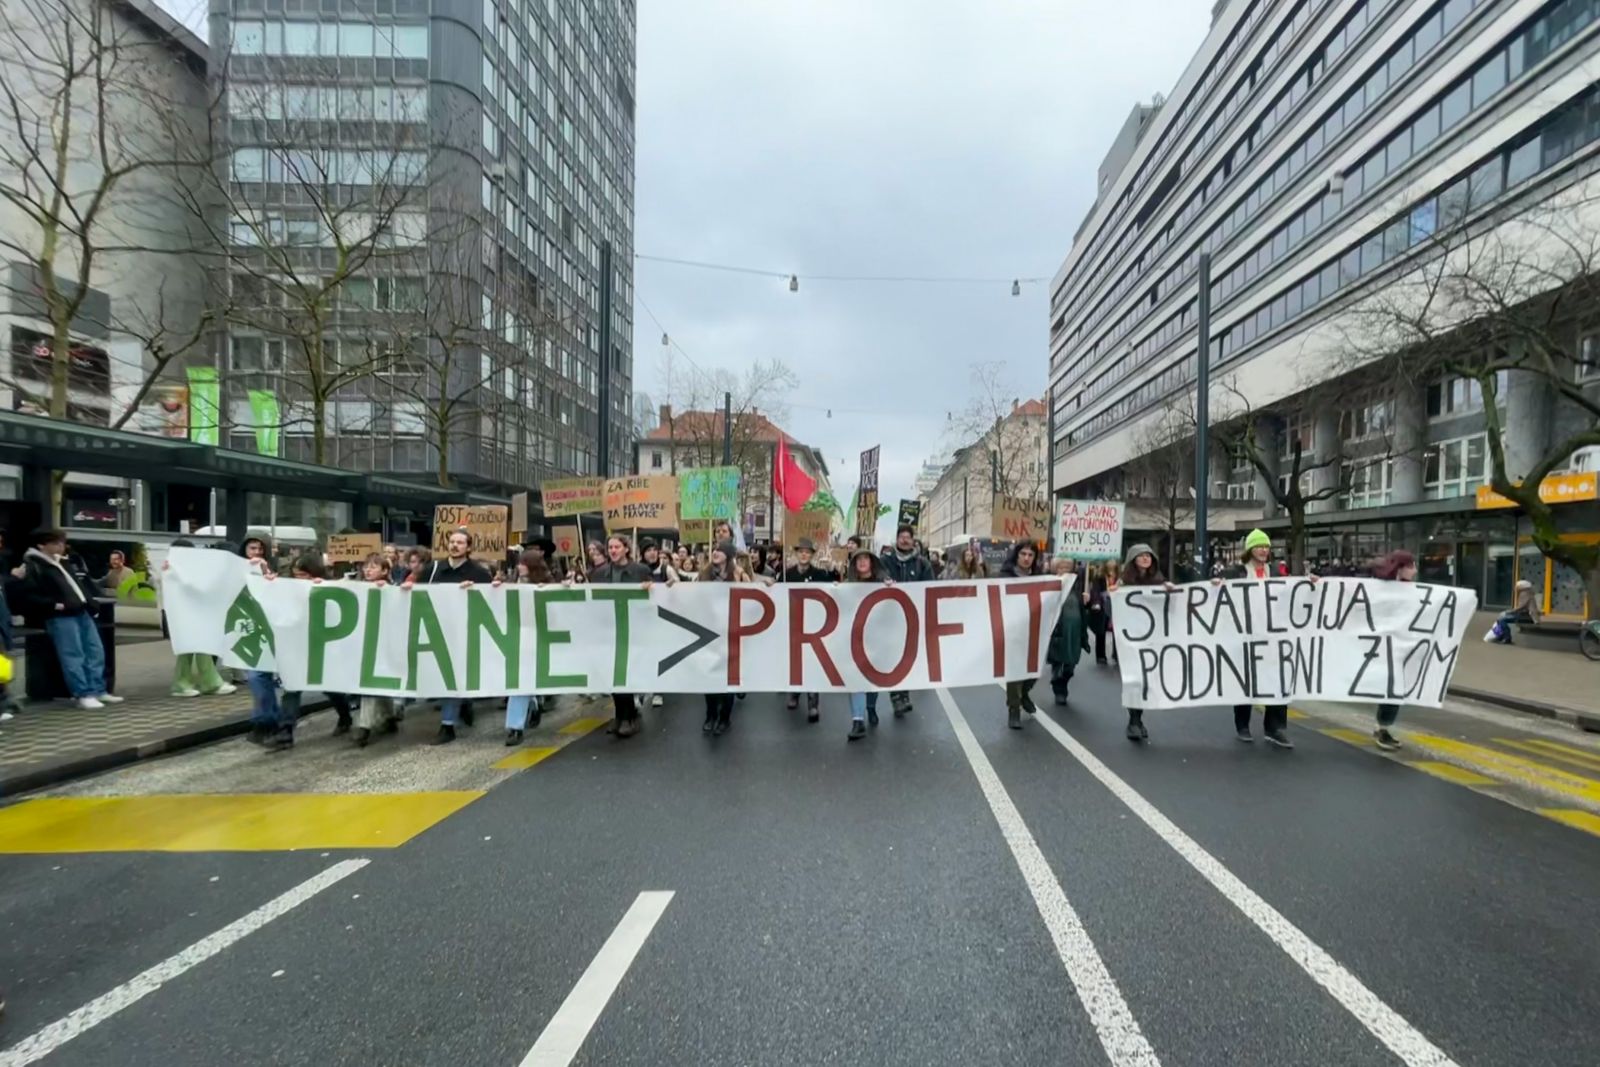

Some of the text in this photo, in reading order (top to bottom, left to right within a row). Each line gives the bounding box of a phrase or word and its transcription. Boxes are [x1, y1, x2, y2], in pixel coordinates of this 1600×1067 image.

[608, 481, 622, 493] ZA
[435, 507, 464, 524] DOST
[608, 509, 620, 520] ZA
[1063, 504, 1117, 519] ZA JAVNO
[1064, 532, 1111, 546] RTV SLO
[1123, 580, 1457, 642] STRATEGIJA ZA
[307, 586, 648, 691] PLANET
[727, 580, 1061, 687] PROFIT
[1139, 635, 1459, 703] PODNEBNI ZLOM
